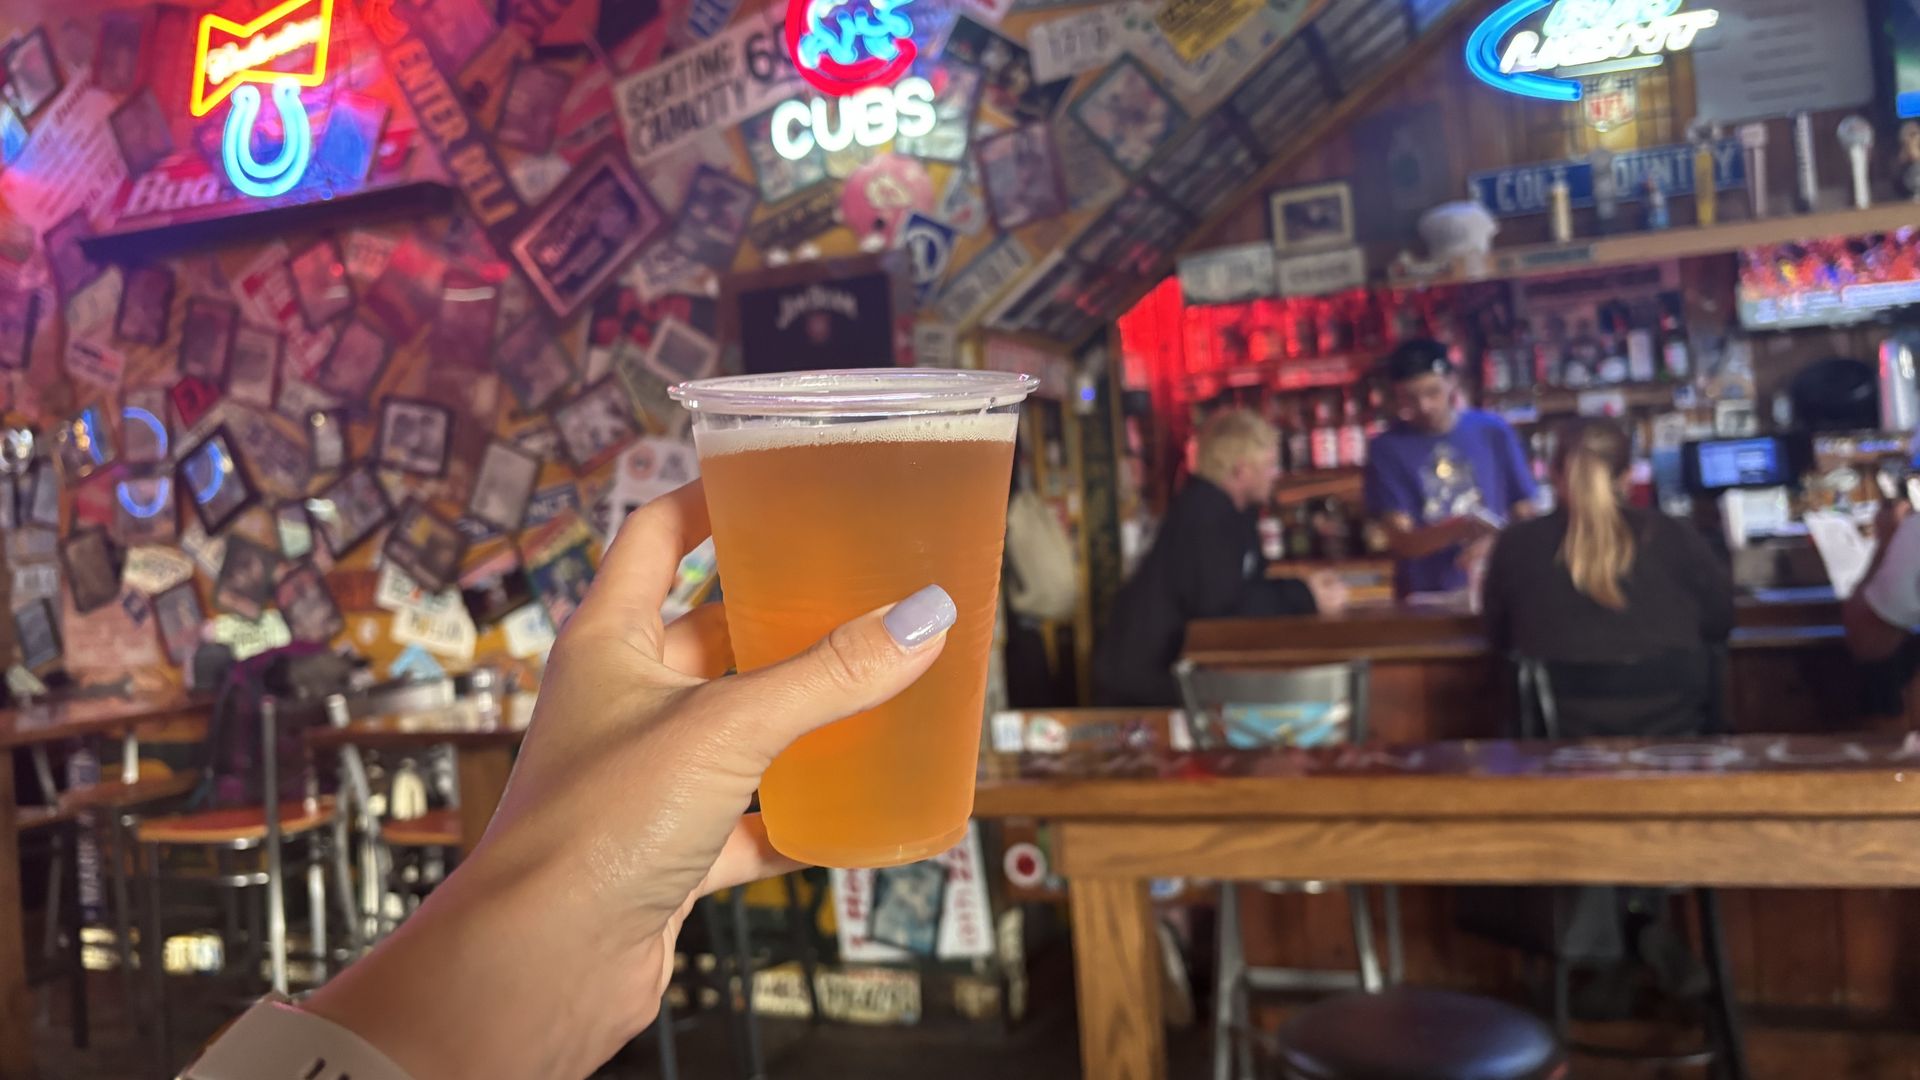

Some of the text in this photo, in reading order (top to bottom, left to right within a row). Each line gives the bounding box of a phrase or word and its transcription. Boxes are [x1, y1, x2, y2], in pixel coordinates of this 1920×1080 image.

[626, 40, 736, 120] SEATING
[771, 77, 936, 160] CUBS
[124, 173, 221, 216] Bud
